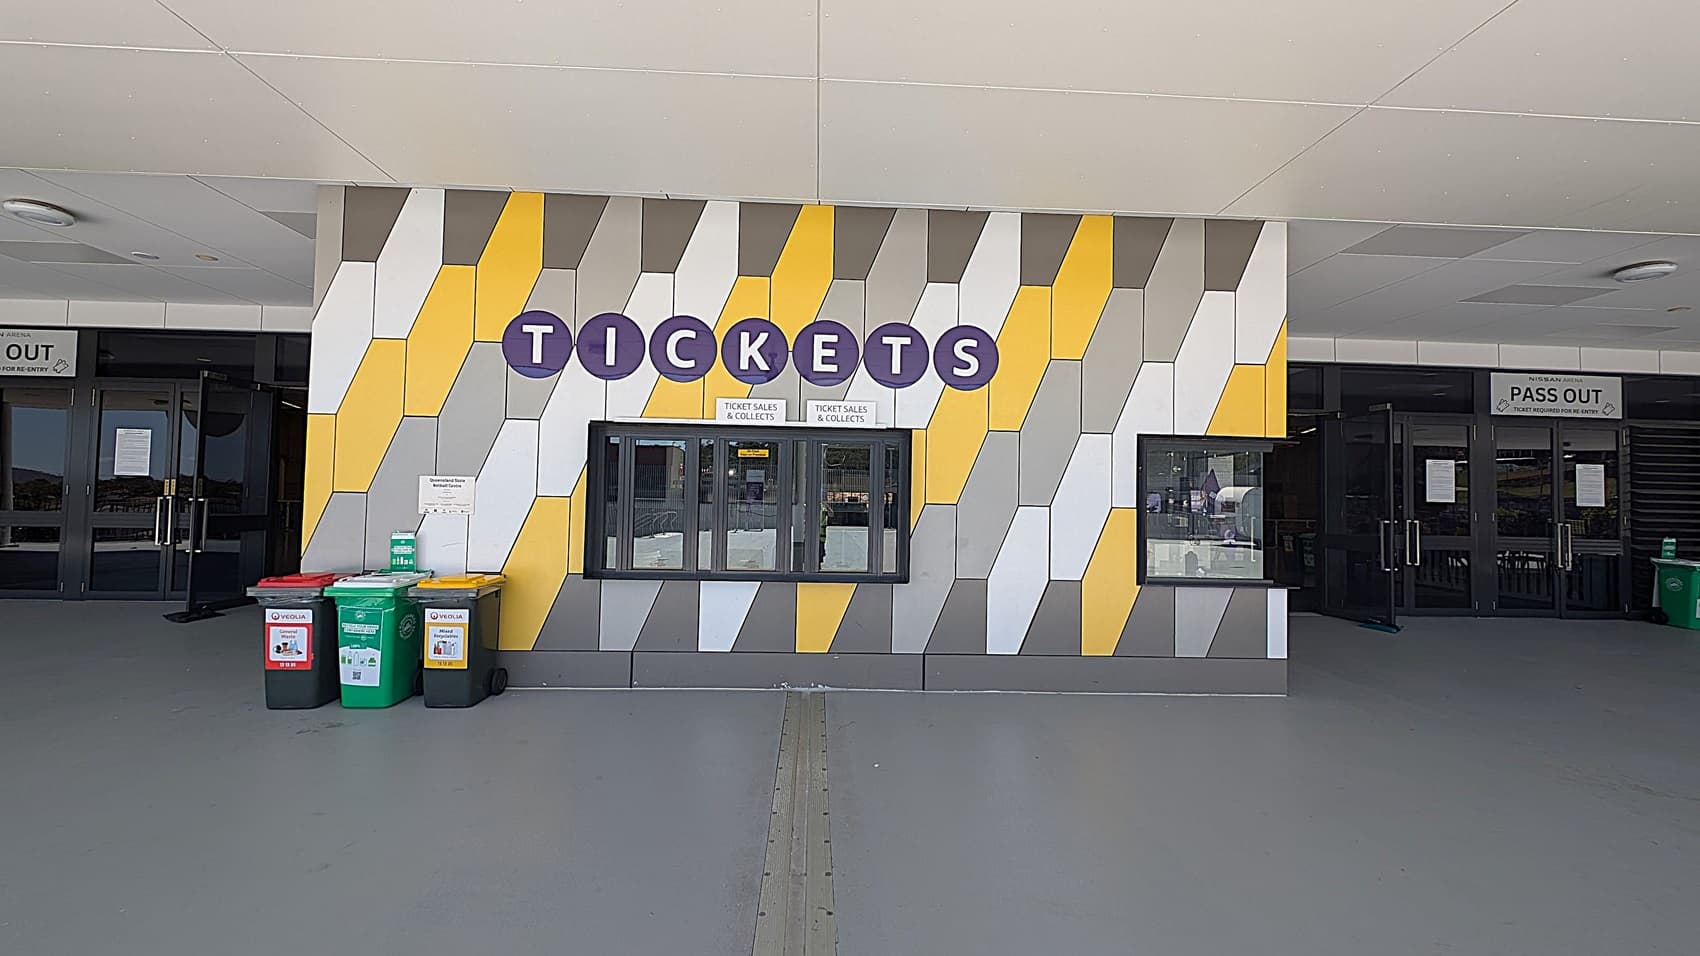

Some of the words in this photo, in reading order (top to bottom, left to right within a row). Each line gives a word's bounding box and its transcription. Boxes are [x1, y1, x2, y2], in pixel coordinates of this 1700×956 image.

[6, 343, 55, 361] OUT
[521, 324, 981, 378] TICKETS
[1510, 386, 1558, 403] PASS
[1563, 388, 1603, 405] OUT
[724, 402, 751, 411] TICKET
[752, 403, 778, 412] SALES
[815, 404, 842, 413] TICKET
[843, 405, 868, 413] SALES
[726, 412, 734, 420] &
[734, 412, 775, 421] COLLECTS
[817, 414, 824, 422] &
[825, 414, 865, 423] COLLECTS
